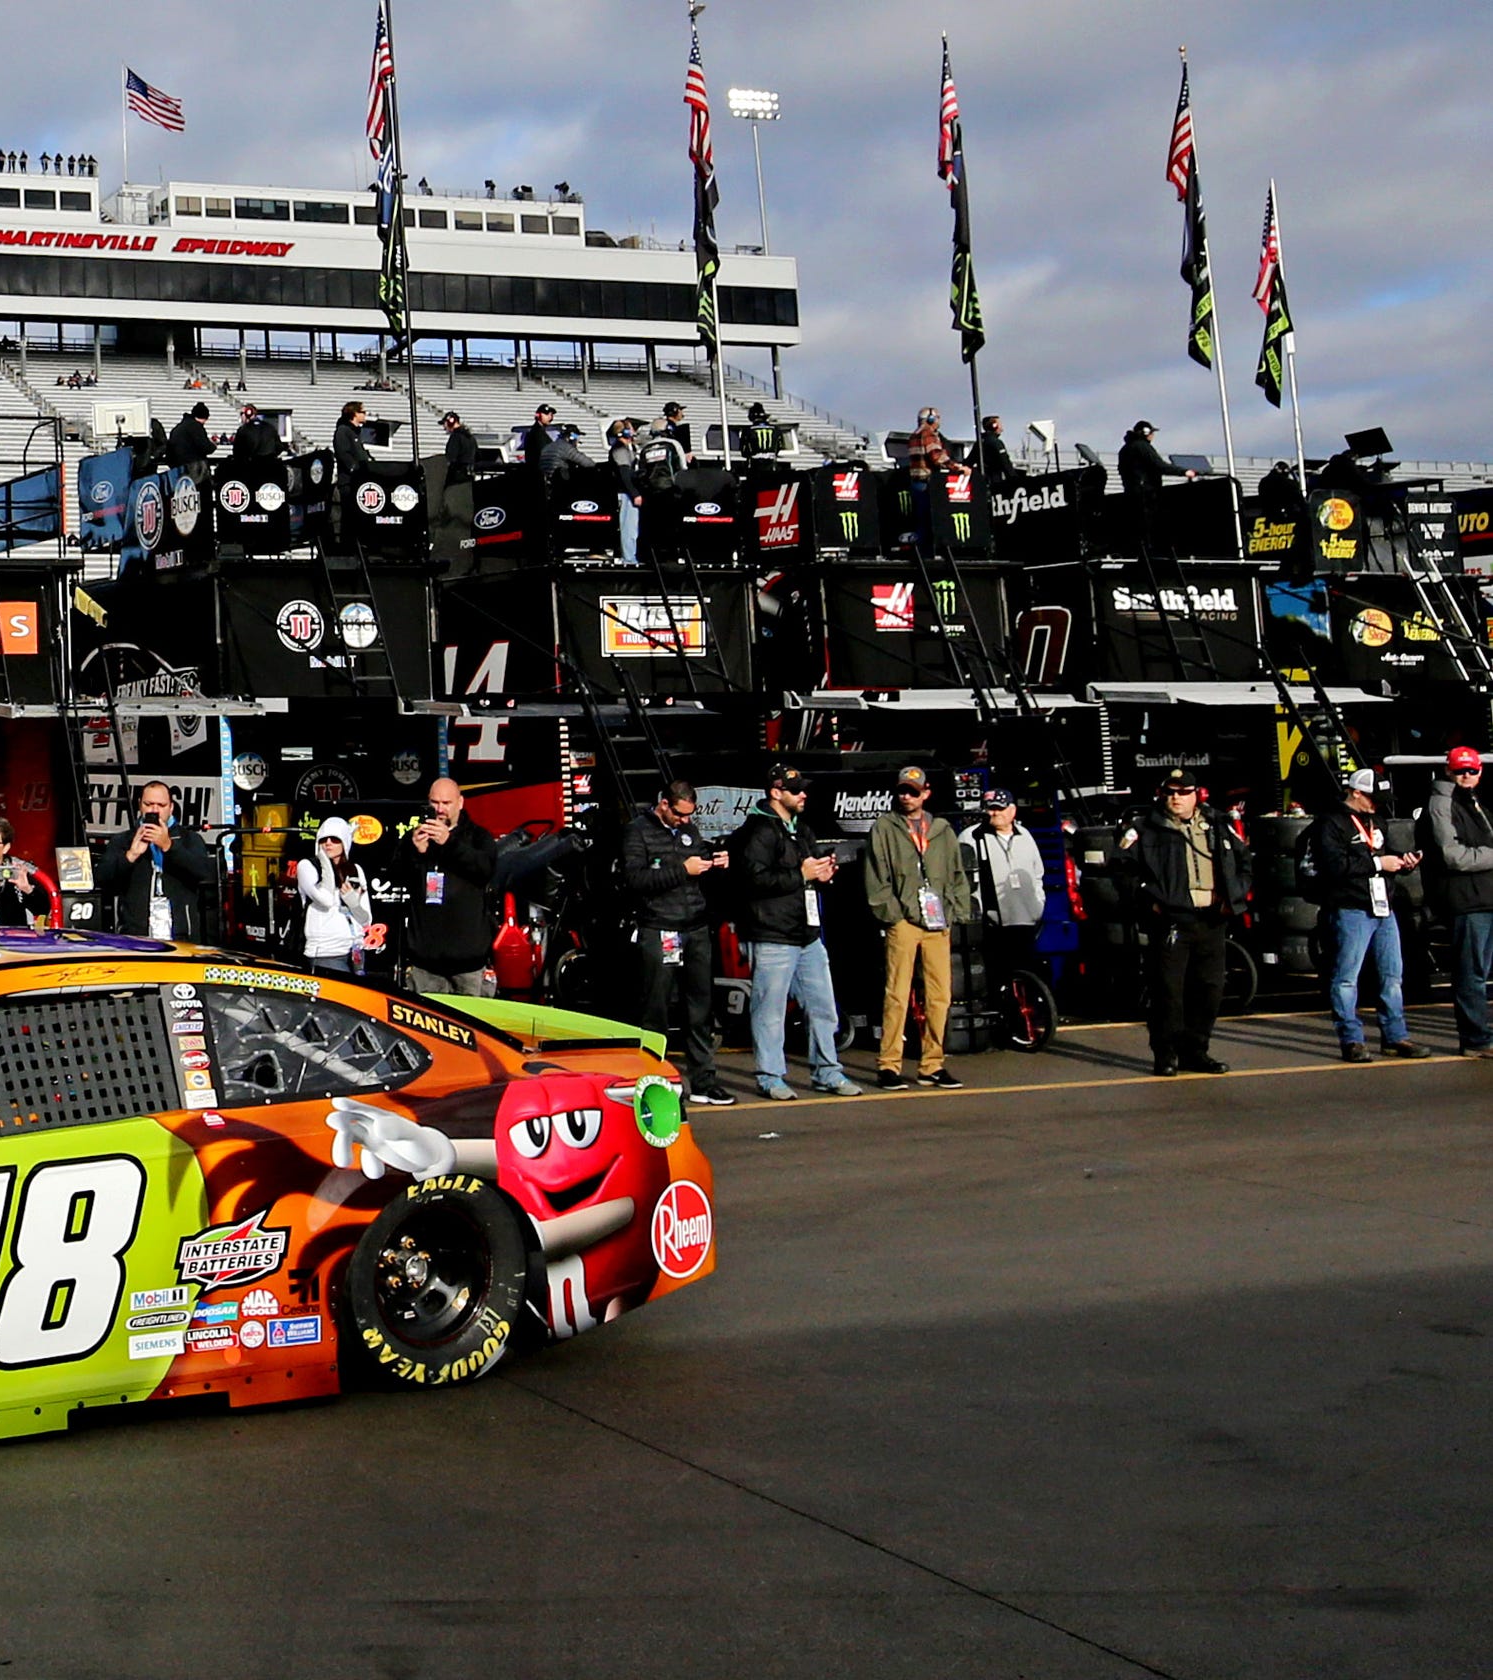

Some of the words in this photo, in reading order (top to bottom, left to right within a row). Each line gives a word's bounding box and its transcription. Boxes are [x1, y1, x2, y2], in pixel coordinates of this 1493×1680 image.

[172, 236, 295, 257] SPEEDWAY
[170, 491, 201, 519] BUSCH
[1253, 517, 1296, 538] 5-hour
[1458, 511, 1489, 533] UTO
[759, 524, 799, 543] HAAS
[1249, 534, 1295, 554] ENERGY
[1112, 585, 1239, 619] Smthfield
[1194, 612, 1238, 621] ACING
[149, 673, 175, 695] FAST!
[1135, 752, 1210, 769] Smithfield
[833, 790, 894, 815] Hendrick
[70, 903, 94, 921] 20
[169, 1000, 203, 1009] TOYOTA
[391, 1003, 471, 1046] STANLEY
[644, 1130, 680, 1148] ETHANOL
[407, 1175, 485, 1199] EAGLE
[659, 1186, 707, 1263] Rheem
[185, 1236, 279, 1258] INTERSTATE
[188, 1253, 274, 1274] BATTERIES
[134, 1291, 169, 1306] Mobil
[171, 1288, 184, 1302] 1
[132, 1313, 186, 1327] FREIGHTLINER
[193, 1306, 238, 1318] DOOSAN
[242, 1307, 279, 1317] TOOLS
[187, 1328, 229, 1341] LINCOLN
[196, 1338, 234, 1349] WELDERS
[135, 1338, 178, 1351] SIEMENS
